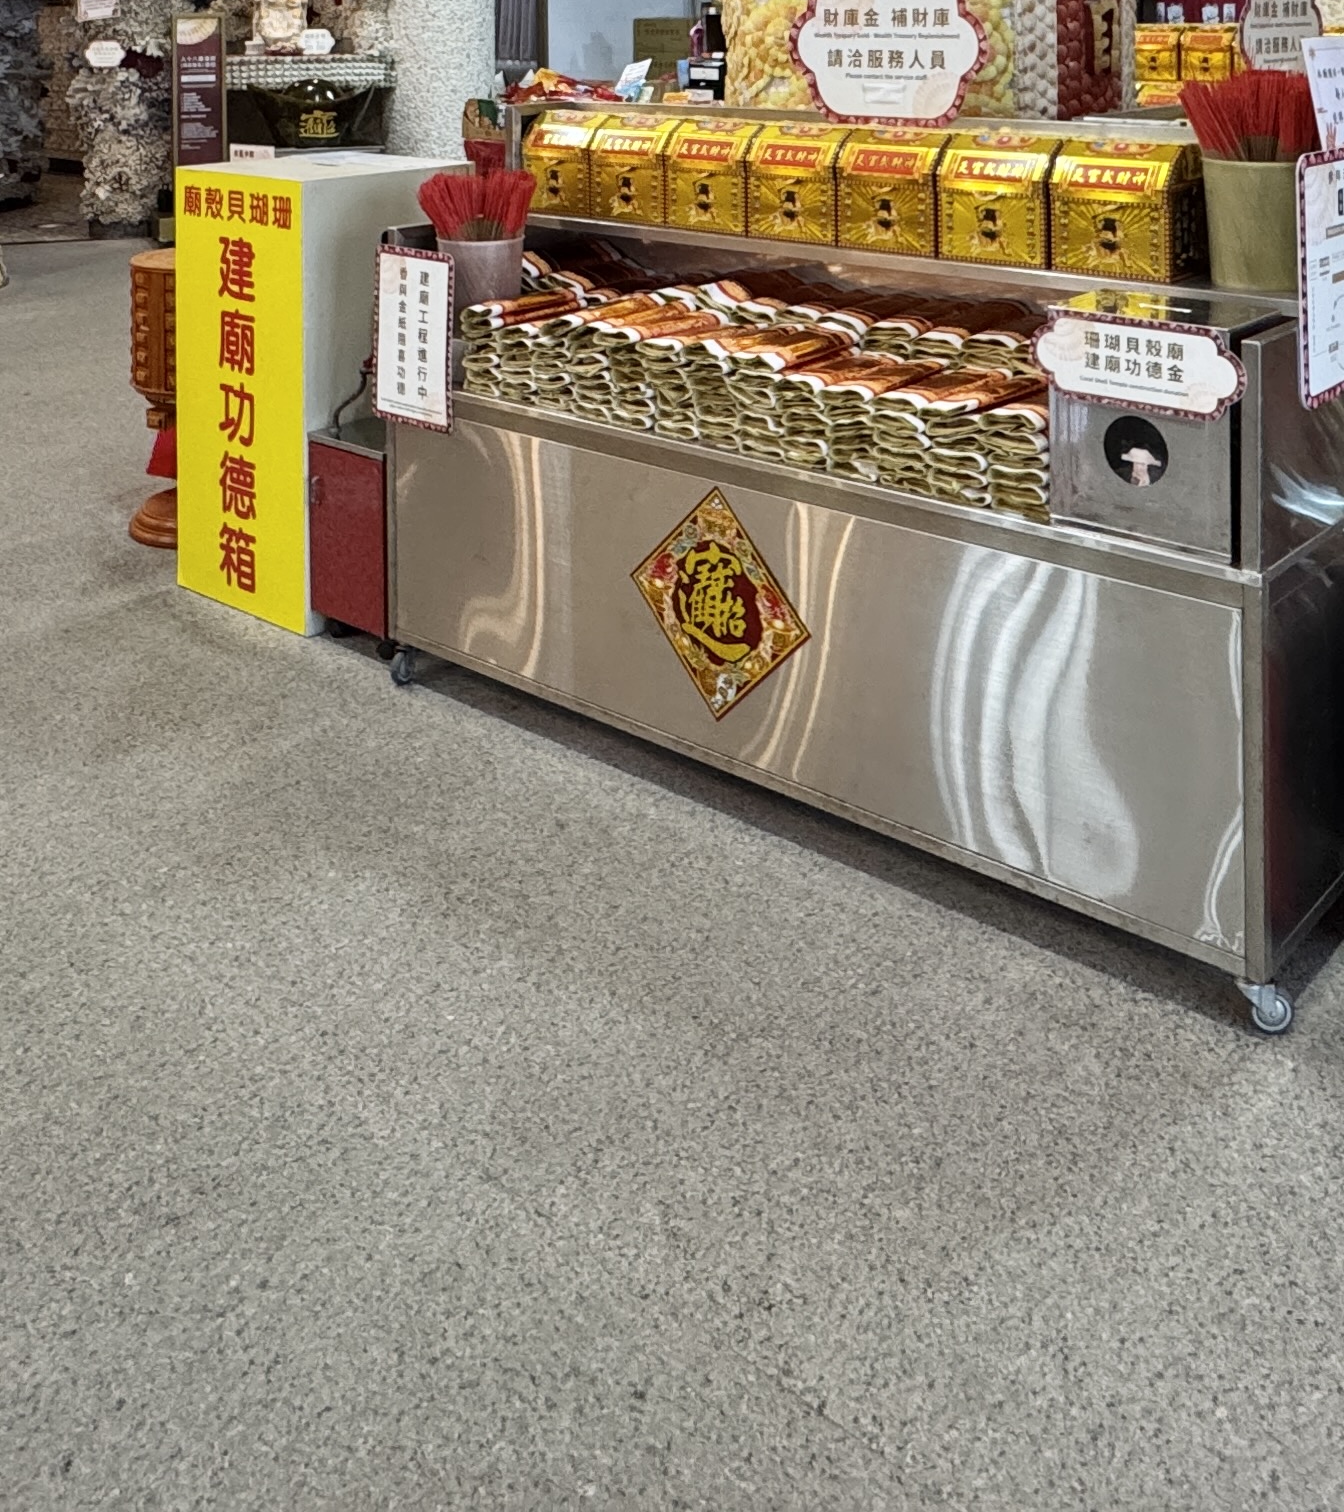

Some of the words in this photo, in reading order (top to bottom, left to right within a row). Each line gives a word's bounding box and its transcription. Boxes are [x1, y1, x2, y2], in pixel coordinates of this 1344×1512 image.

[823, 8, 880, 27] 財庫金
[891, 7, 950, 27] 補財庫
[827, 48, 946, 70] 請洽服務人員
[417, 271, 430, 400] 建廟工程進行中
[1084, 330, 1184, 361] 珊瑚貝殼廟
[1084, 351, 1184, 383] 建廟功德金
[218, 235, 256, 594] 建廟功德箱
